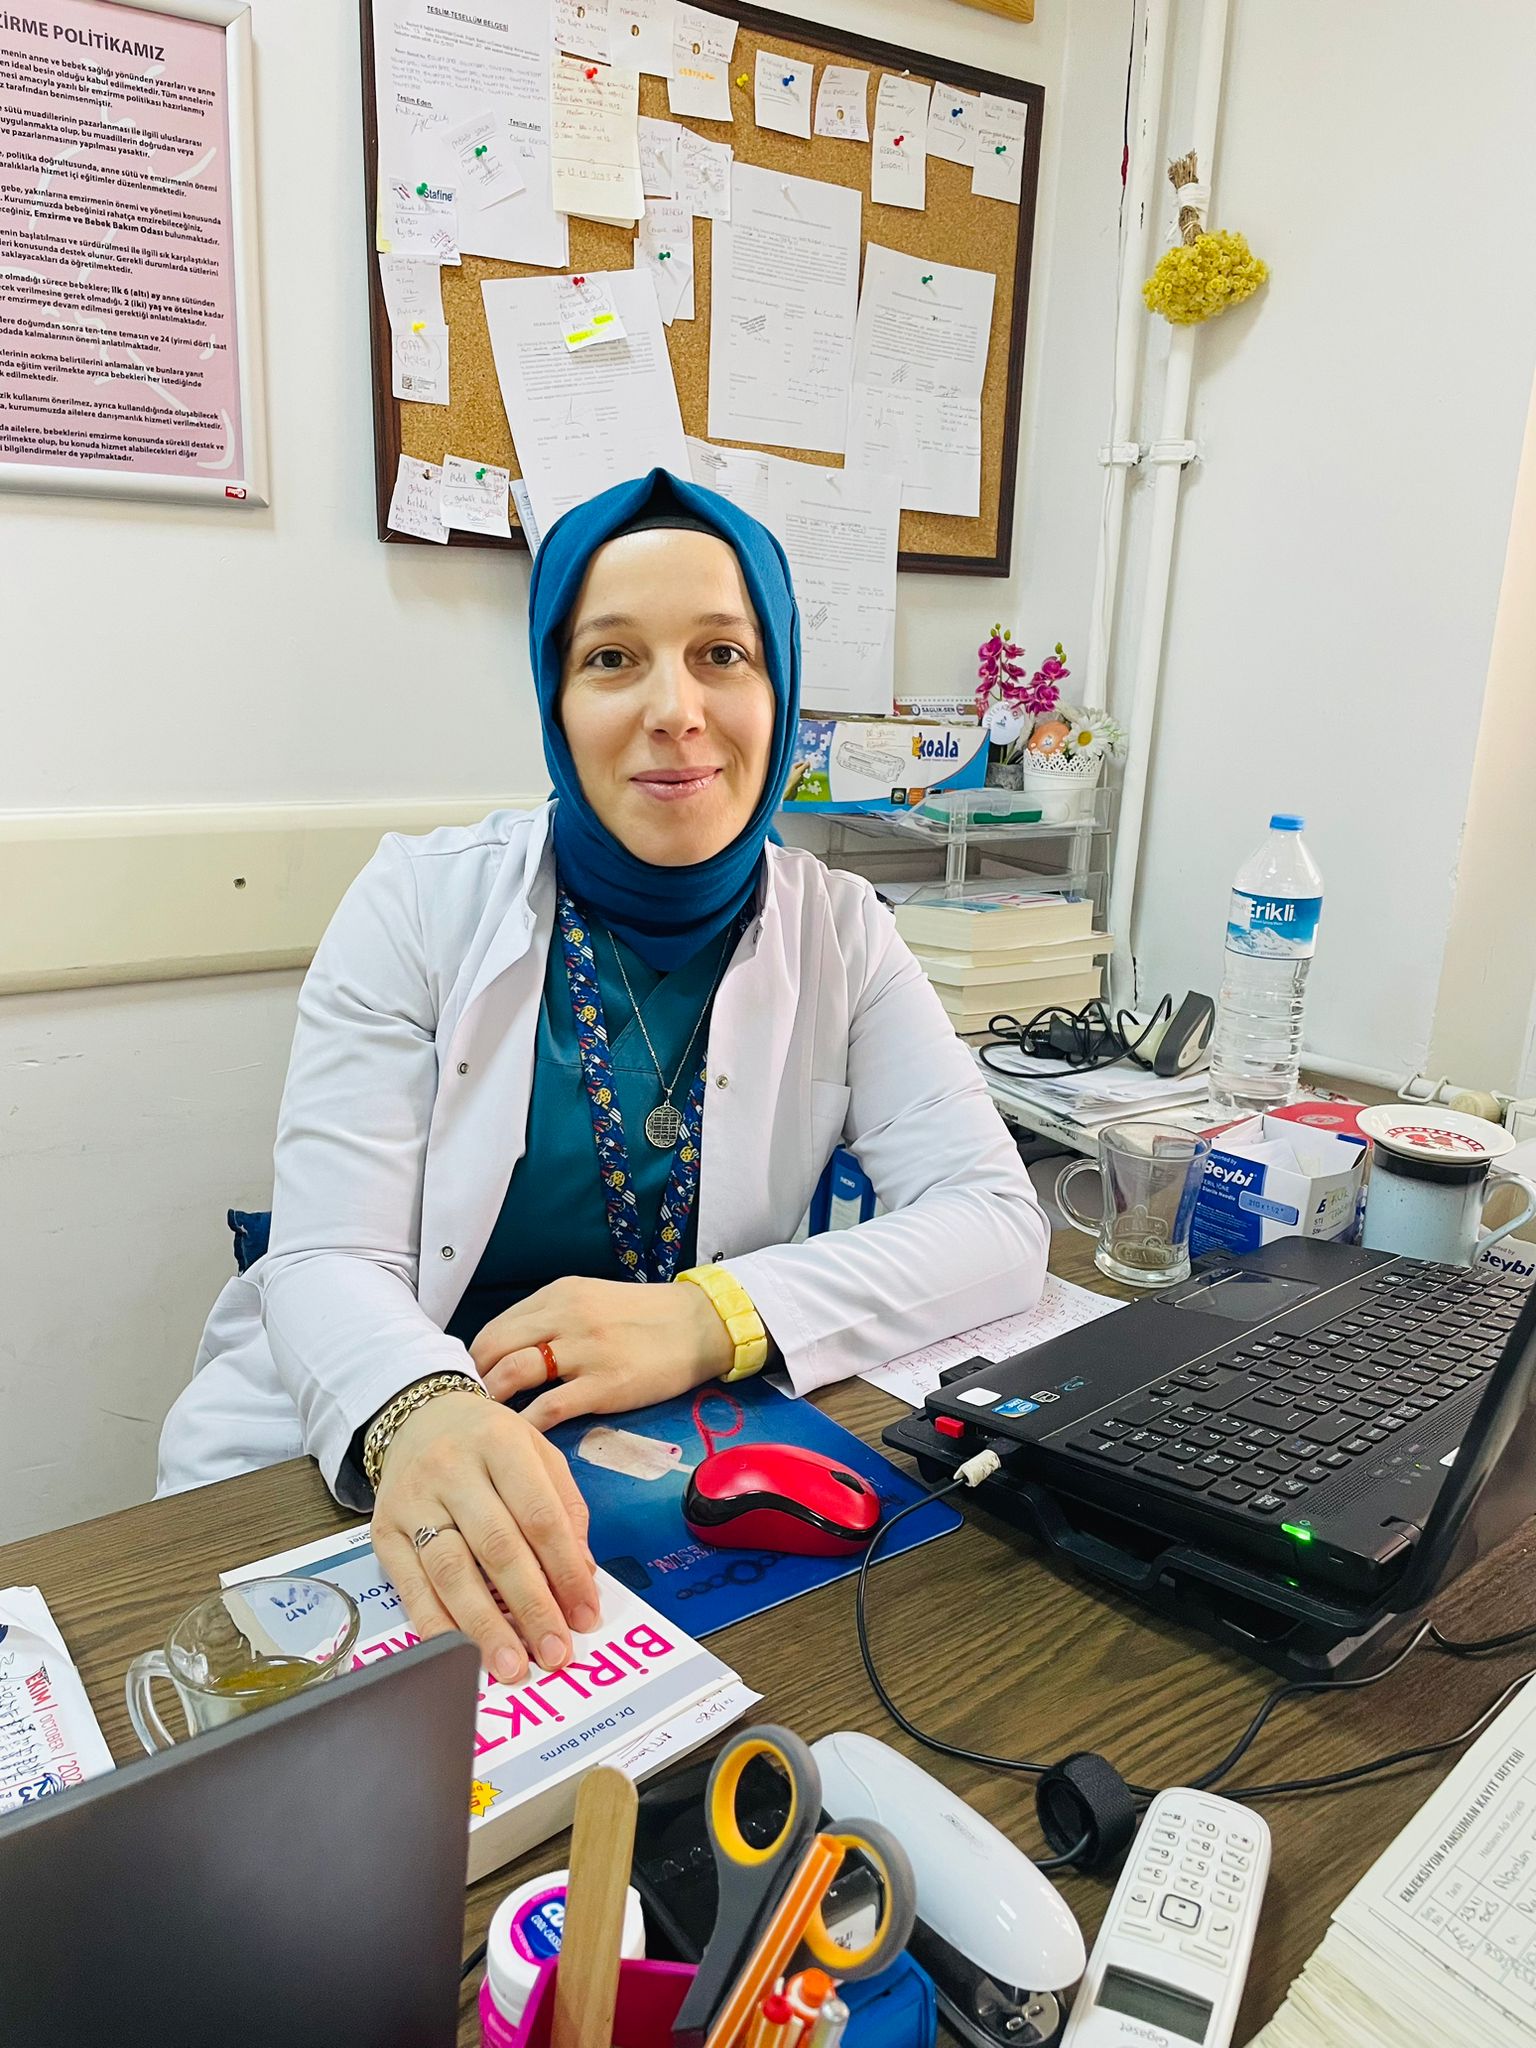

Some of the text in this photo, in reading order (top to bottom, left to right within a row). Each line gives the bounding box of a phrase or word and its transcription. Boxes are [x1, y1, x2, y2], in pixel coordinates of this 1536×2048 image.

[0, 13, 165, 62] İRME POLİTİKAMIZ
[397, 94, 432, 107] Teslim Eden
[509, 118, 542, 131] Teslim Alan
[423, 188, 453, 202] Stafine
[917, 732, 959, 760] koala
[1249, 901, 1295, 922] Erikli
[1204, 1159, 1254, 1187] Beybi
[25, 1671, 52, 1706] EKİM
[39, 1713, 64, 1752] OCTOBER
[57, 1759, 85, 1787] 202
[540, 1704, 635, 1764] Dr. David Burns
[1400, 1747, 1526, 1904] ENJEKSİYON PANSUMAN KAYIT DEFTERİ
[1119, 2021, 1169, 2048] Gigaset
